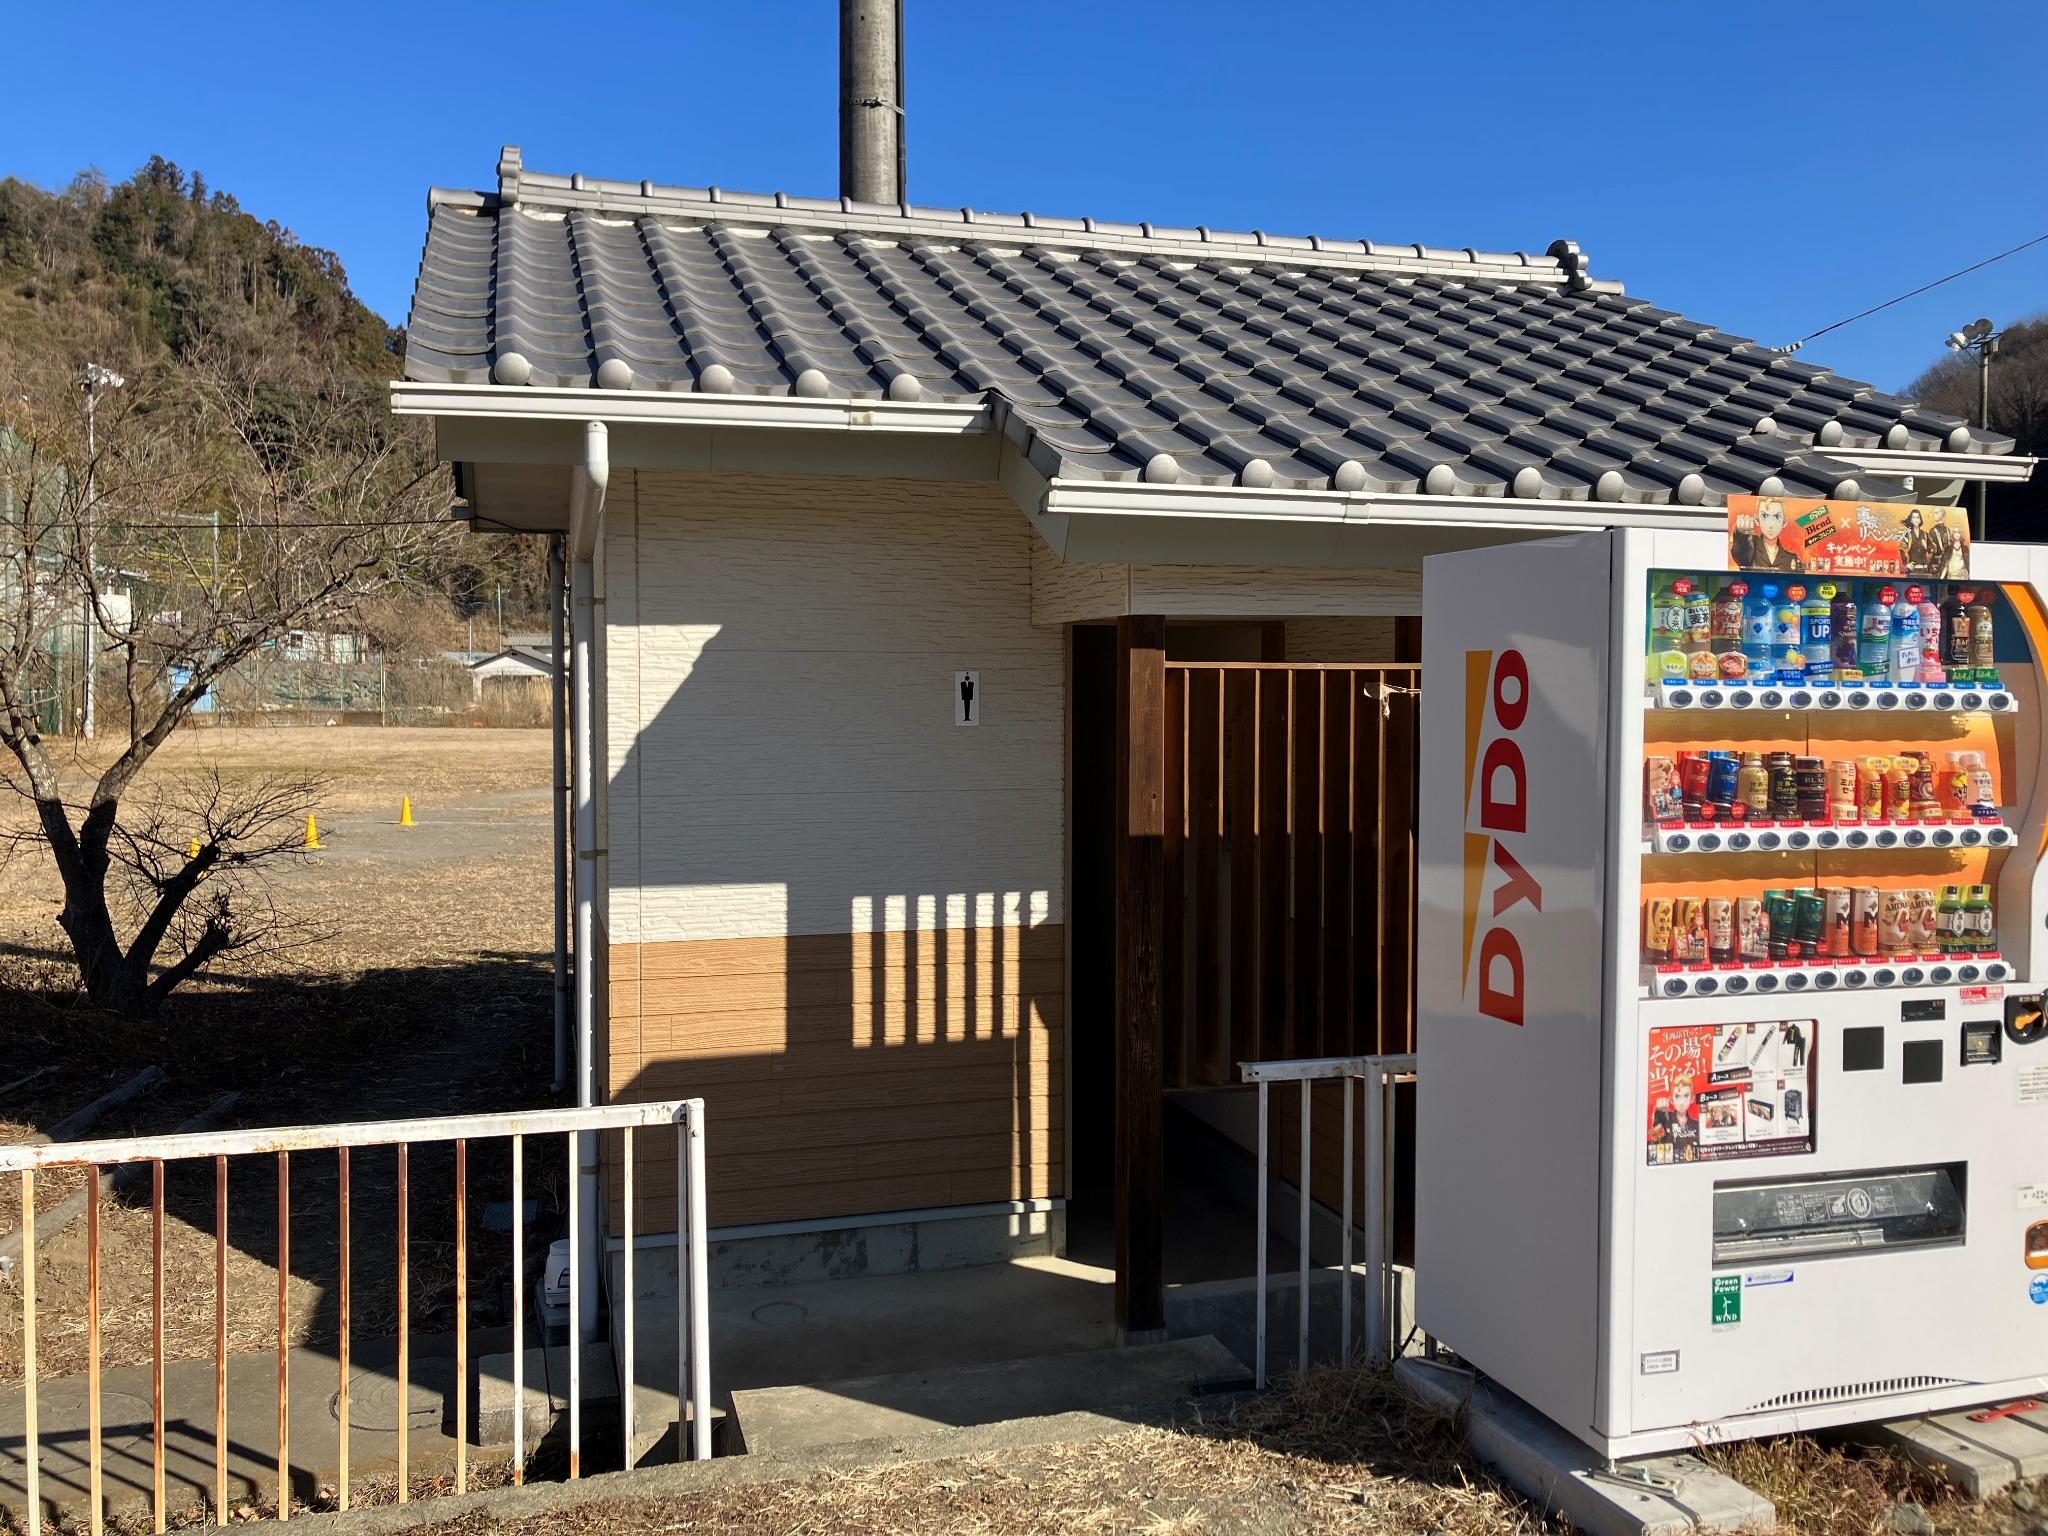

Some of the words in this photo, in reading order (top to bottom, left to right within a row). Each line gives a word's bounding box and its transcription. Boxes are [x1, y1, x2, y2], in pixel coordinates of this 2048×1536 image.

[1805, 516, 1832, 536] Blend
[1826, 542, 1876, 556] キャンペーン
[1812, 624, 1831, 638] UP
[1649, 1033, 1712, 1066] その場で
[1649, 1058, 1707, 1095] 当たる!!
[1714, 1278, 1738, 1286] Green
[1714, 1285, 1739, 1293] Power
[1715, 1313, 1737, 1322] WIND
